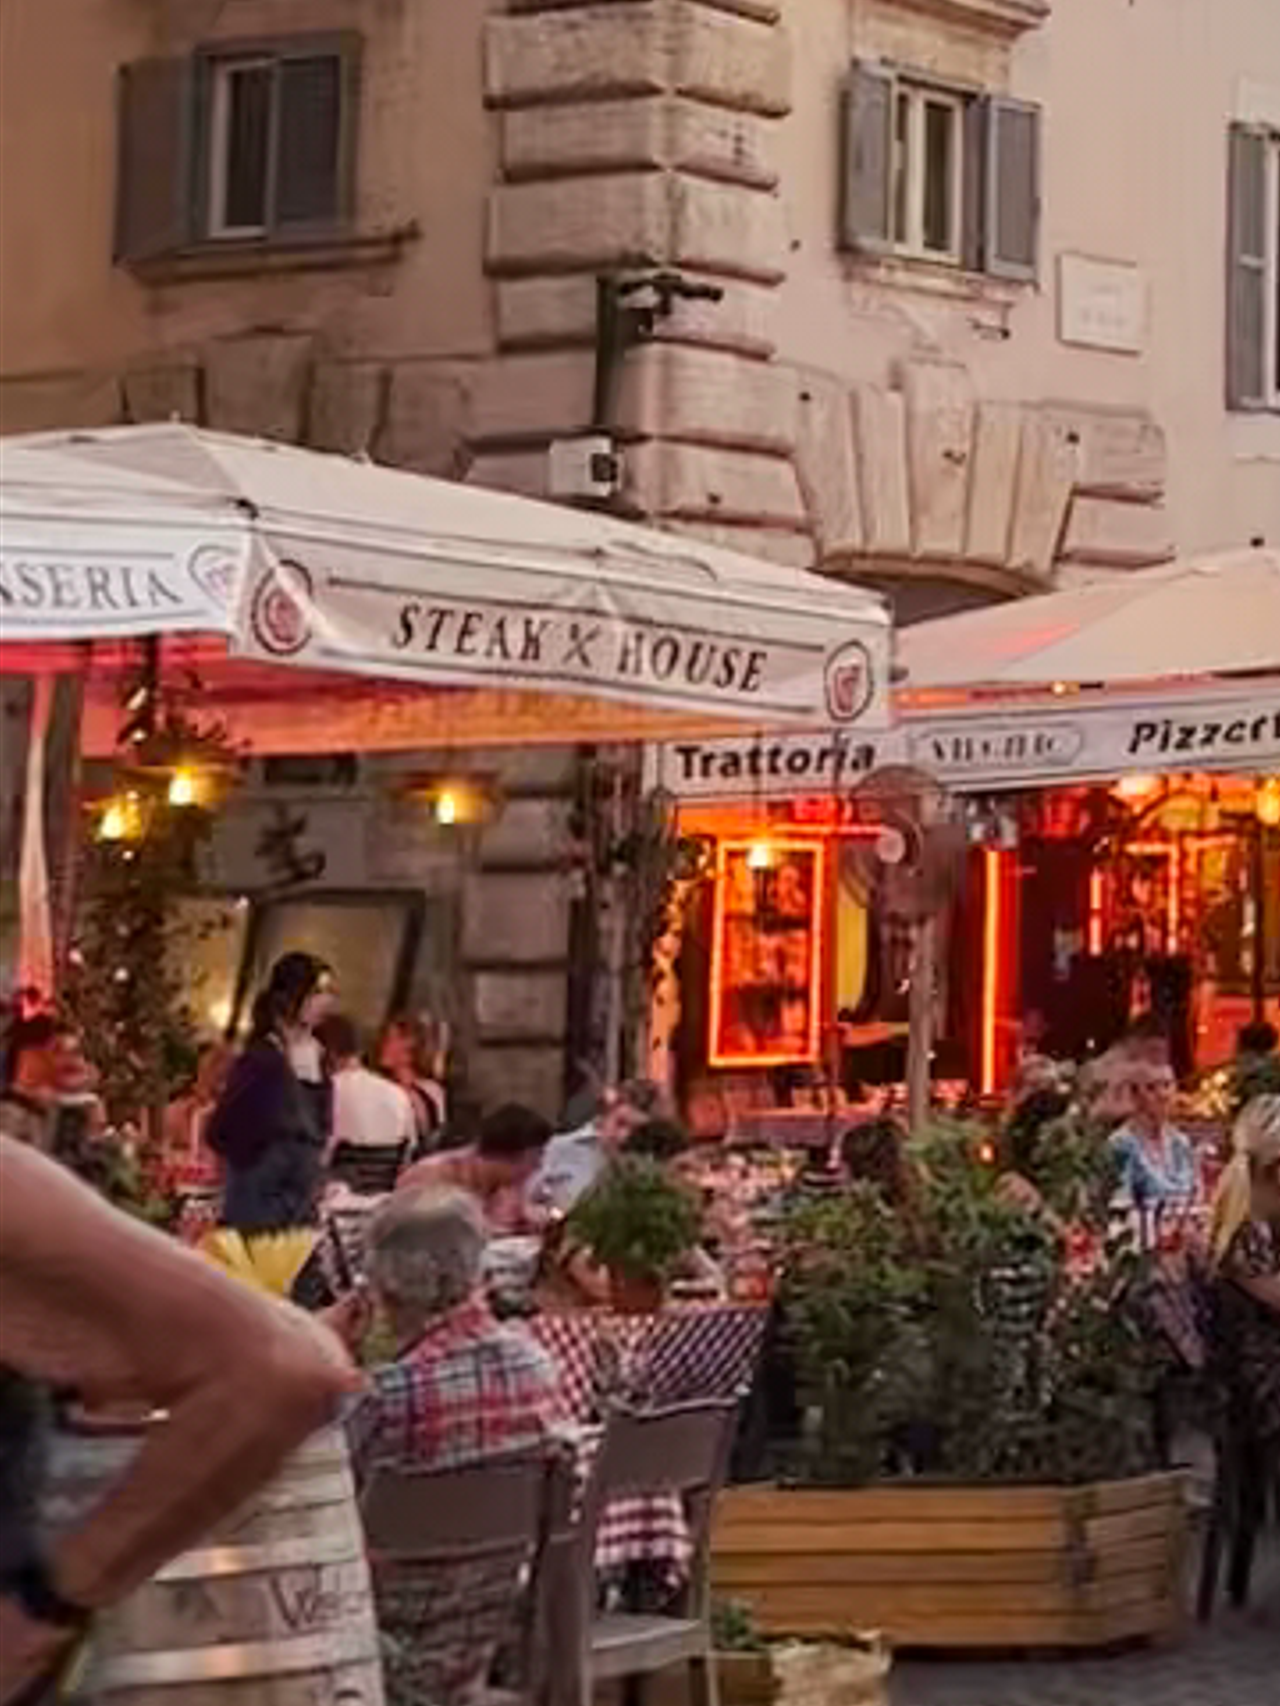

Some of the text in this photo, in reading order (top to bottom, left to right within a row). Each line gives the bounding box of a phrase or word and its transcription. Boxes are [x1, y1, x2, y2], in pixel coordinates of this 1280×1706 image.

[392, 604, 767, 693] STEAK HOUSE
[675, 737, 876, 780] Trattoria
